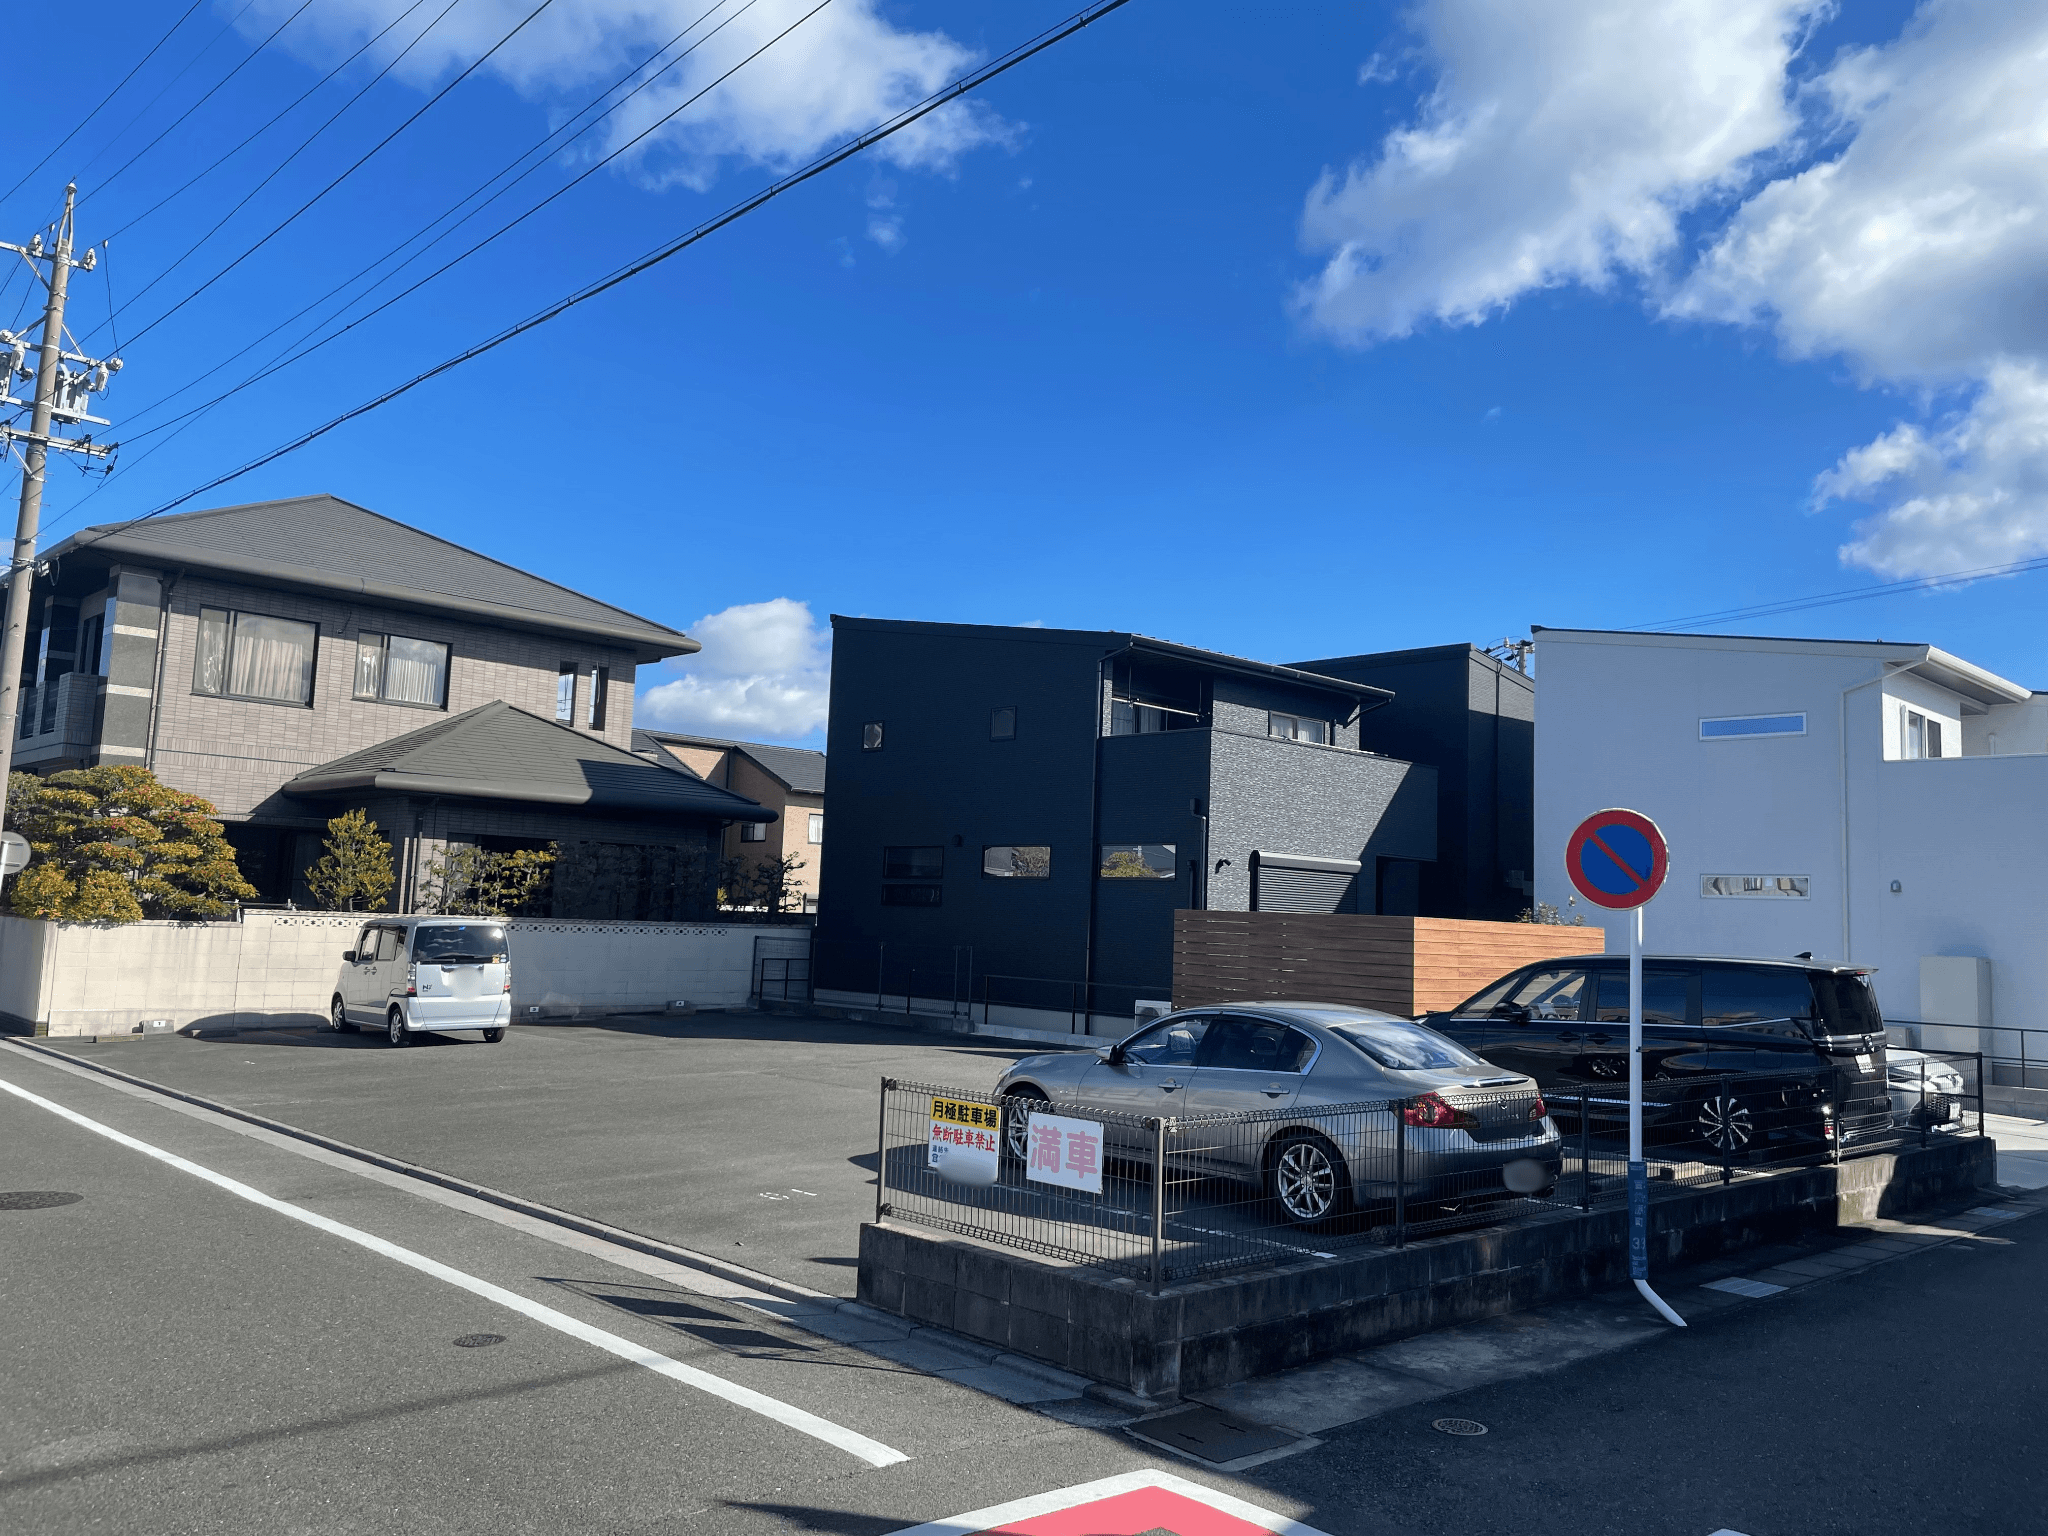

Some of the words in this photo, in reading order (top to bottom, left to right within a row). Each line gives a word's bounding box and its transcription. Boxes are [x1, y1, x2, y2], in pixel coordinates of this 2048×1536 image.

[933, 1101, 997, 1128] 月極駐車場
[932, 1124, 995, 1152] 無断駐車禁止
[1030, 1124, 1098, 1179] 満車
